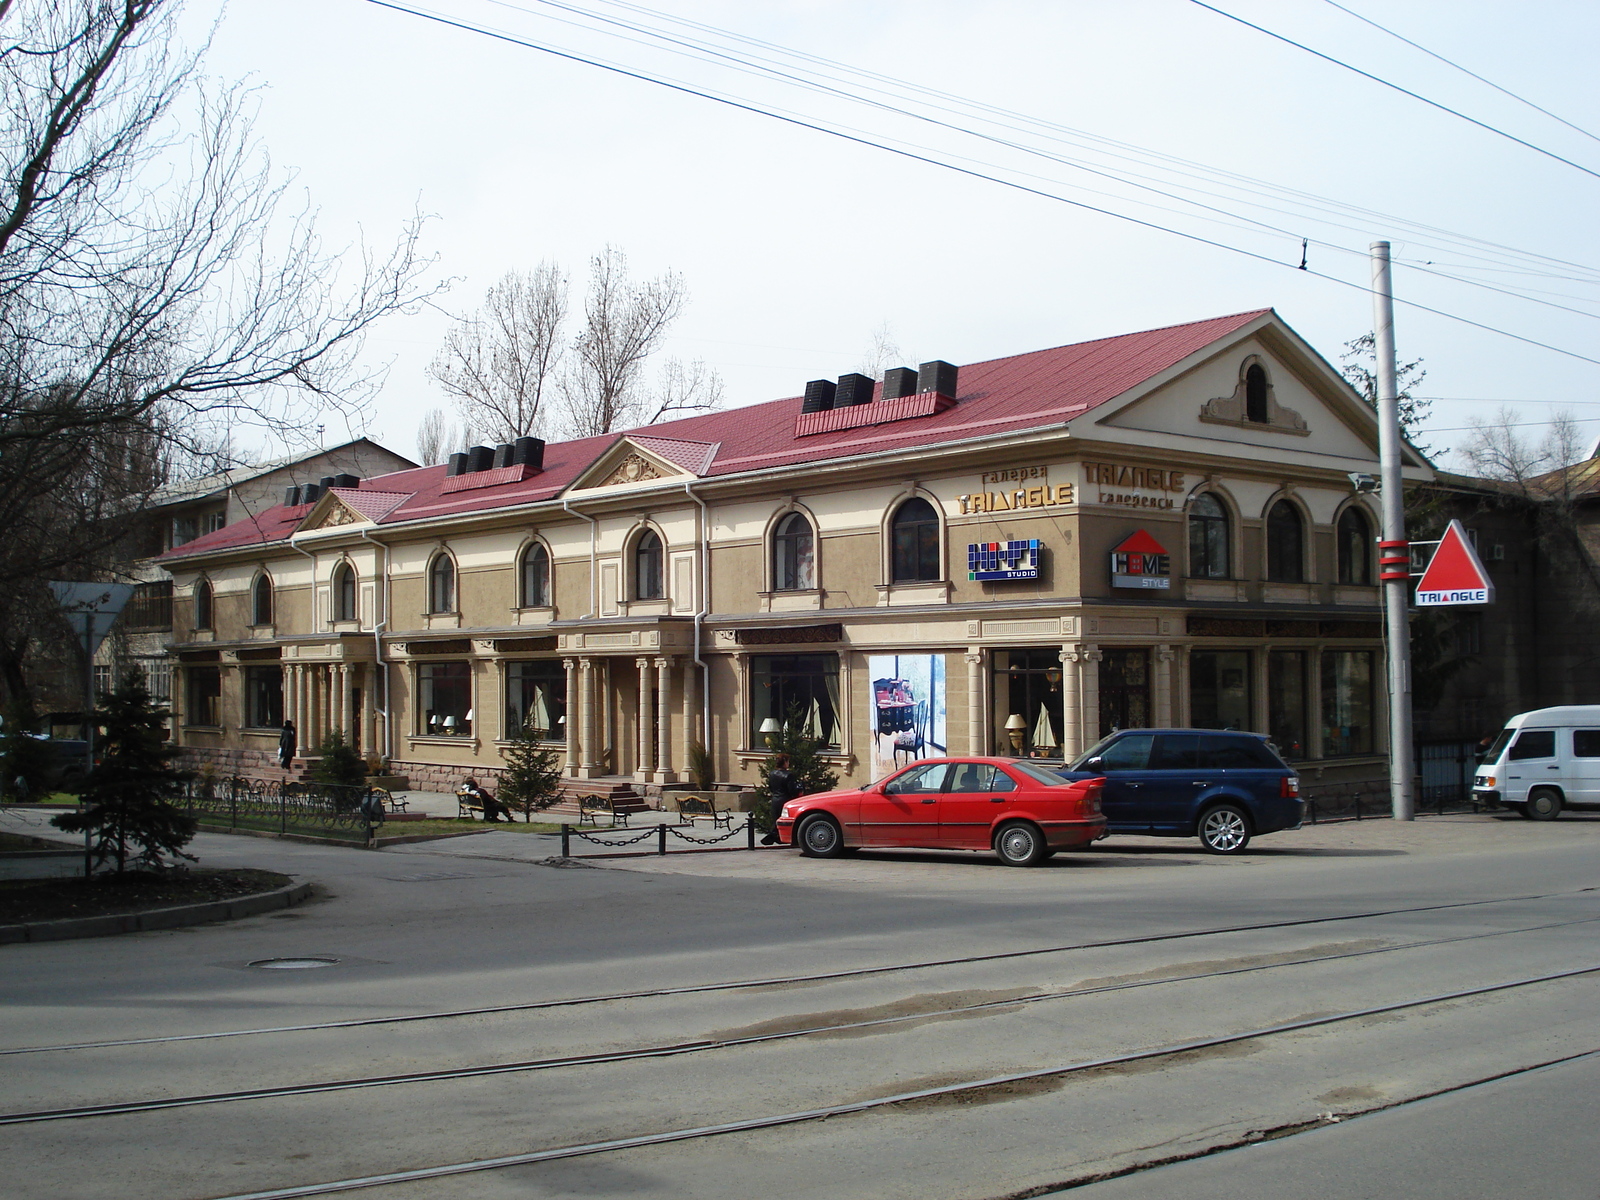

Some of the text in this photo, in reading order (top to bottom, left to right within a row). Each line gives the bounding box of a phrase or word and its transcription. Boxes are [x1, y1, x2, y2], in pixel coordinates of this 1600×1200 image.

[1082, 461, 1184, 493] TRIANGLE
[955, 482, 1073, 514] TRIANGLE
[1114, 553, 1170, 575] HOME
[1142, 578, 1169, 587] STYLE
[1419, 591, 1485, 602] TRIANGLE
